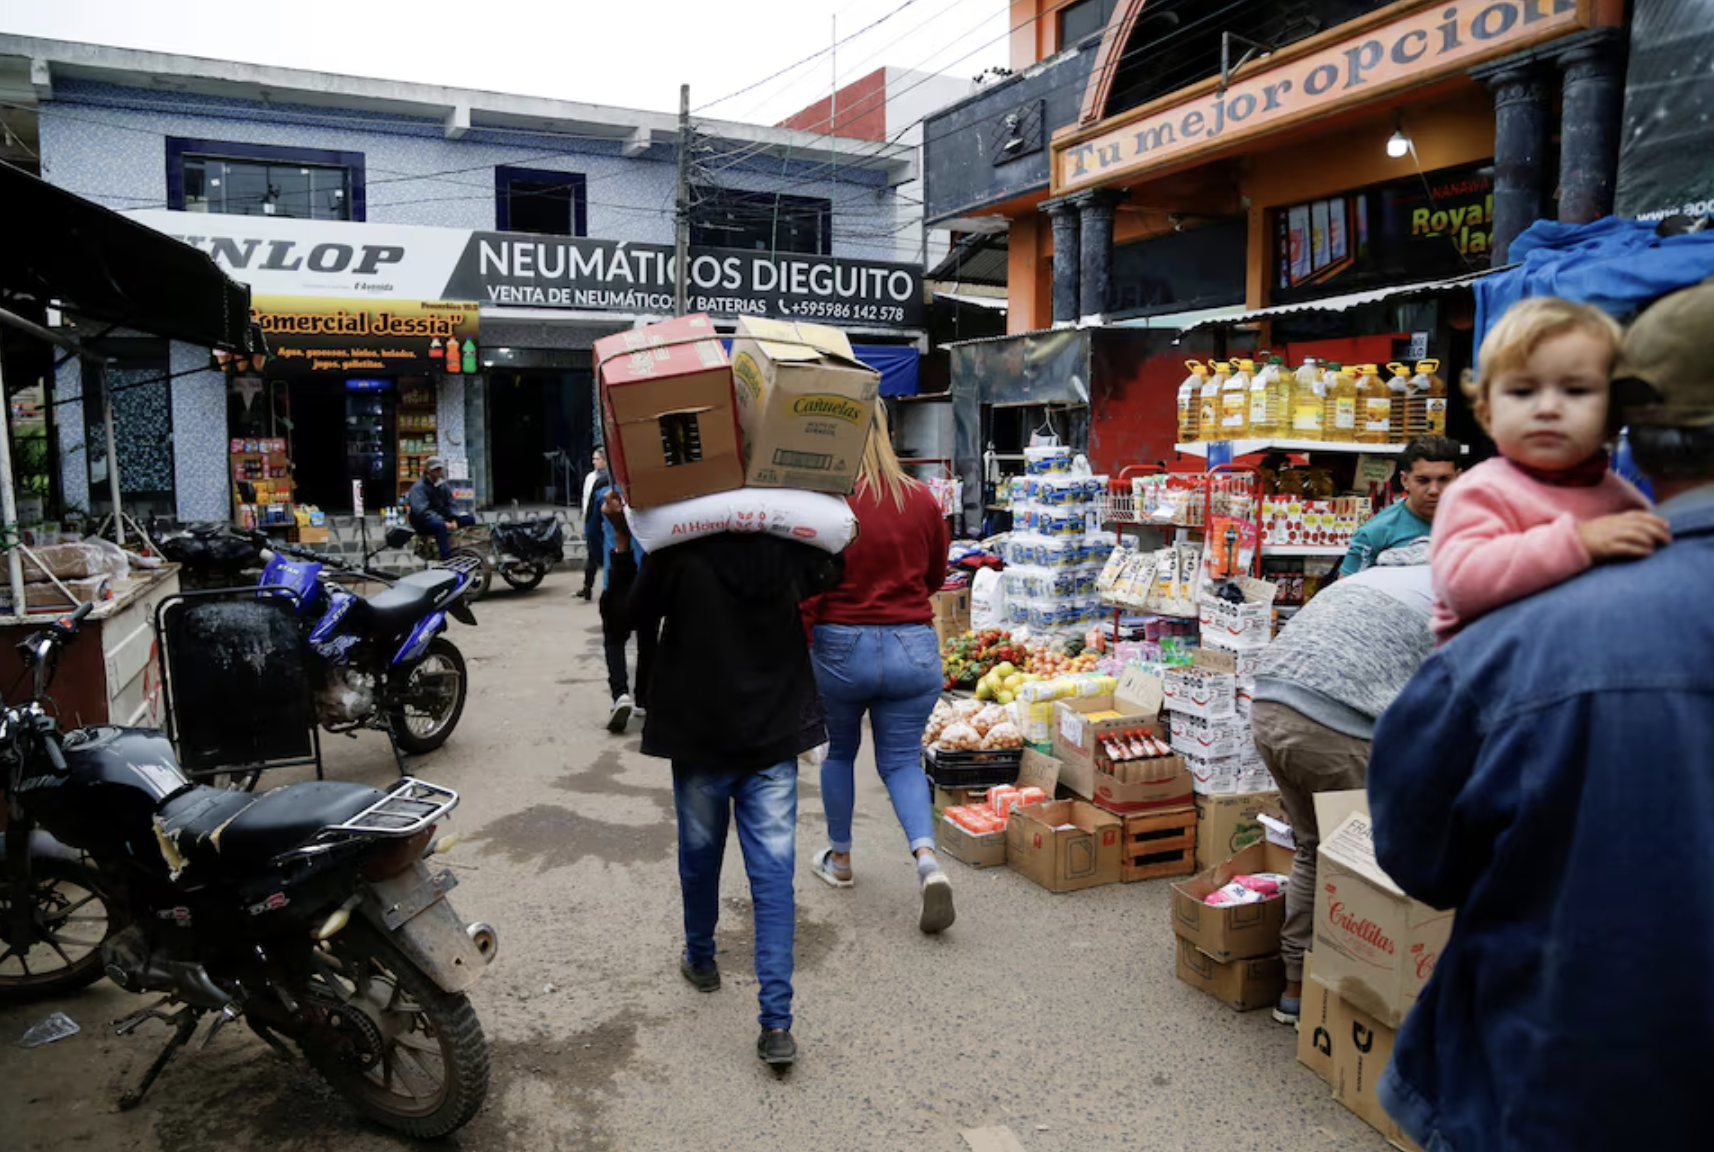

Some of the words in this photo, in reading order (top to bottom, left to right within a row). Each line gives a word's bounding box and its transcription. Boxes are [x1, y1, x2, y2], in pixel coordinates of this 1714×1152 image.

[1066, 141, 1123, 178] Tu
[1133, 79, 1293, 156] mejor
[1411, 193, 1494, 236] Royal
[169, 234, 405, 275] NLOP
[479, 240, 742, 290] NEUMÁTICOS
[752, 258, 914, 301] DIEGUITO
[251, 308, 368, 334] omercial
[487, 285, 545, 303] VENTA
[549, 288, 570, 304] DE
[575, 289, 676, 309] NEUMÁTICO
[686, 296, 695, 310] Y
[697, 296, 766, 313] BATERIAS
[853, 306, 878, 319] 142
[879, 307, 904, 321] 578
[792, 398, 862, 421] Cañuelas
[671, 522, 687, 535] Al
[276, 563, 300, 576] STAR
[1346, 819, 1374, 840] FRA
[1328, 897, 1395, 955] Criollitas
